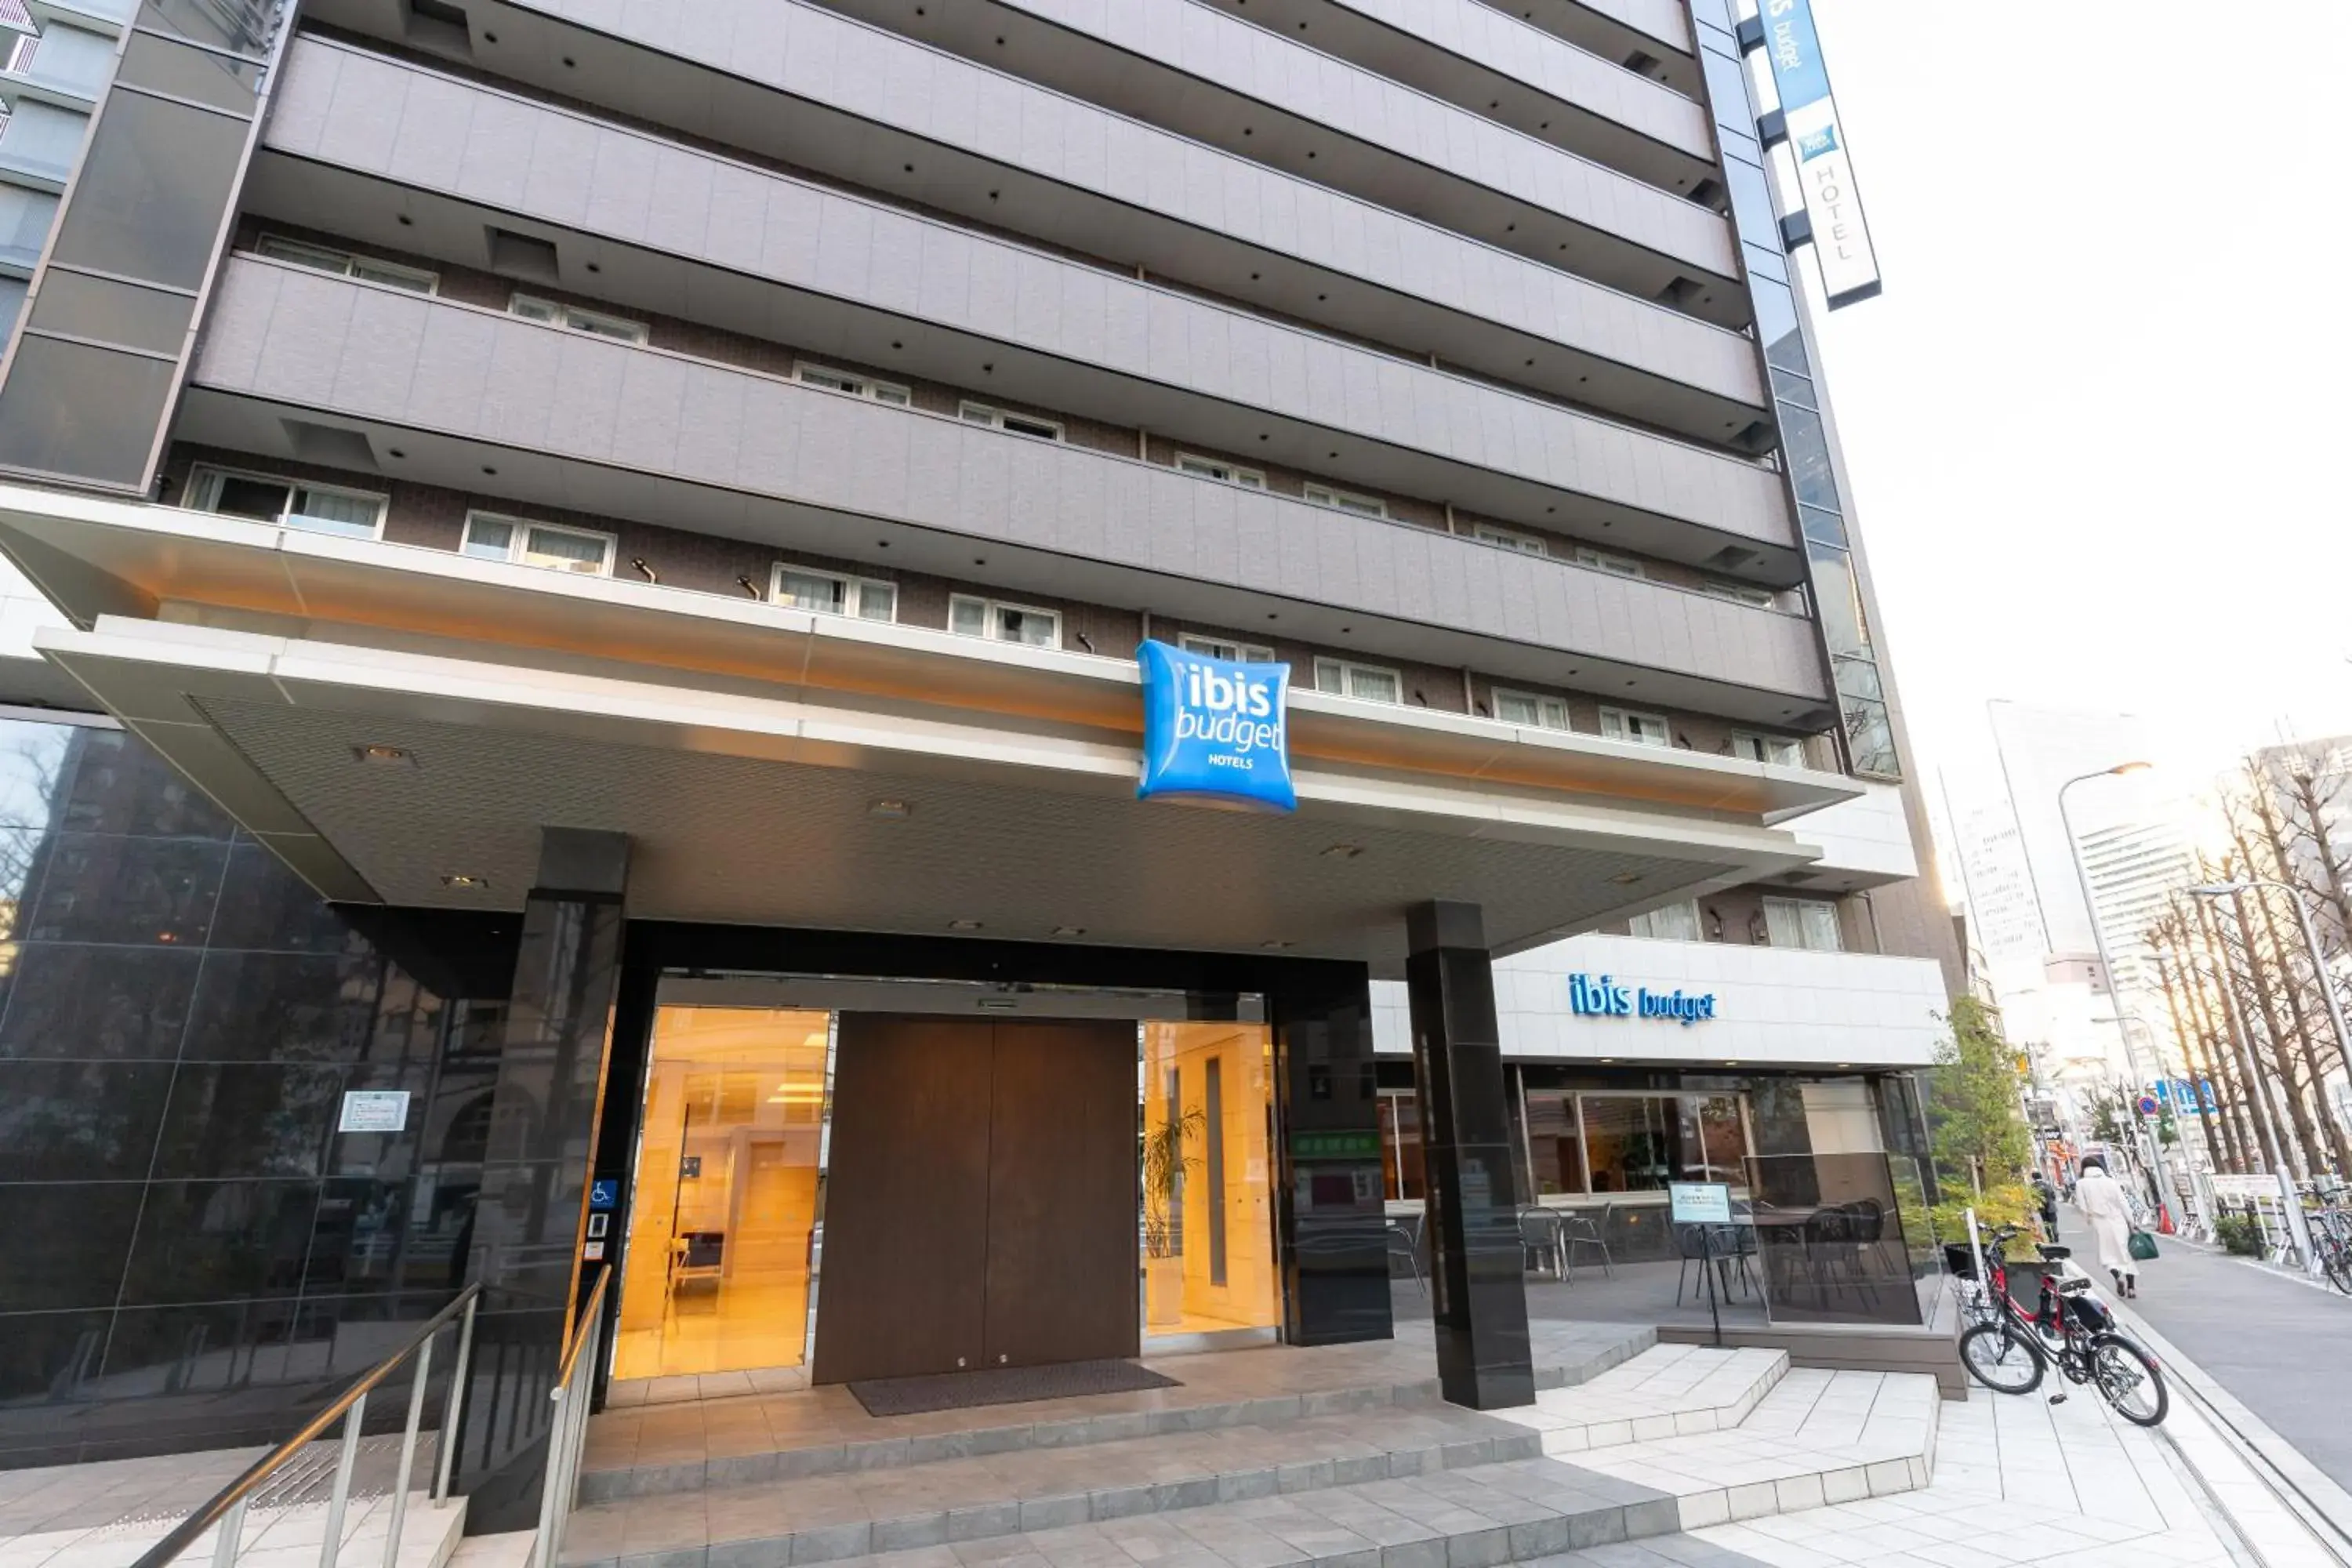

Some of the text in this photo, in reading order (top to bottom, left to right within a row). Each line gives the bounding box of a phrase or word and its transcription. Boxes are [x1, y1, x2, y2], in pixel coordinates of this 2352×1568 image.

[1817, 165, 1852, 260] HOTEL
[1189, 663, 1270, 717] ibis
[1176, 705, 1282, 753] budget
[1208, 753, 1254, 769] HOTELS
[1569, 973, 1716, 1025] ibis budget
